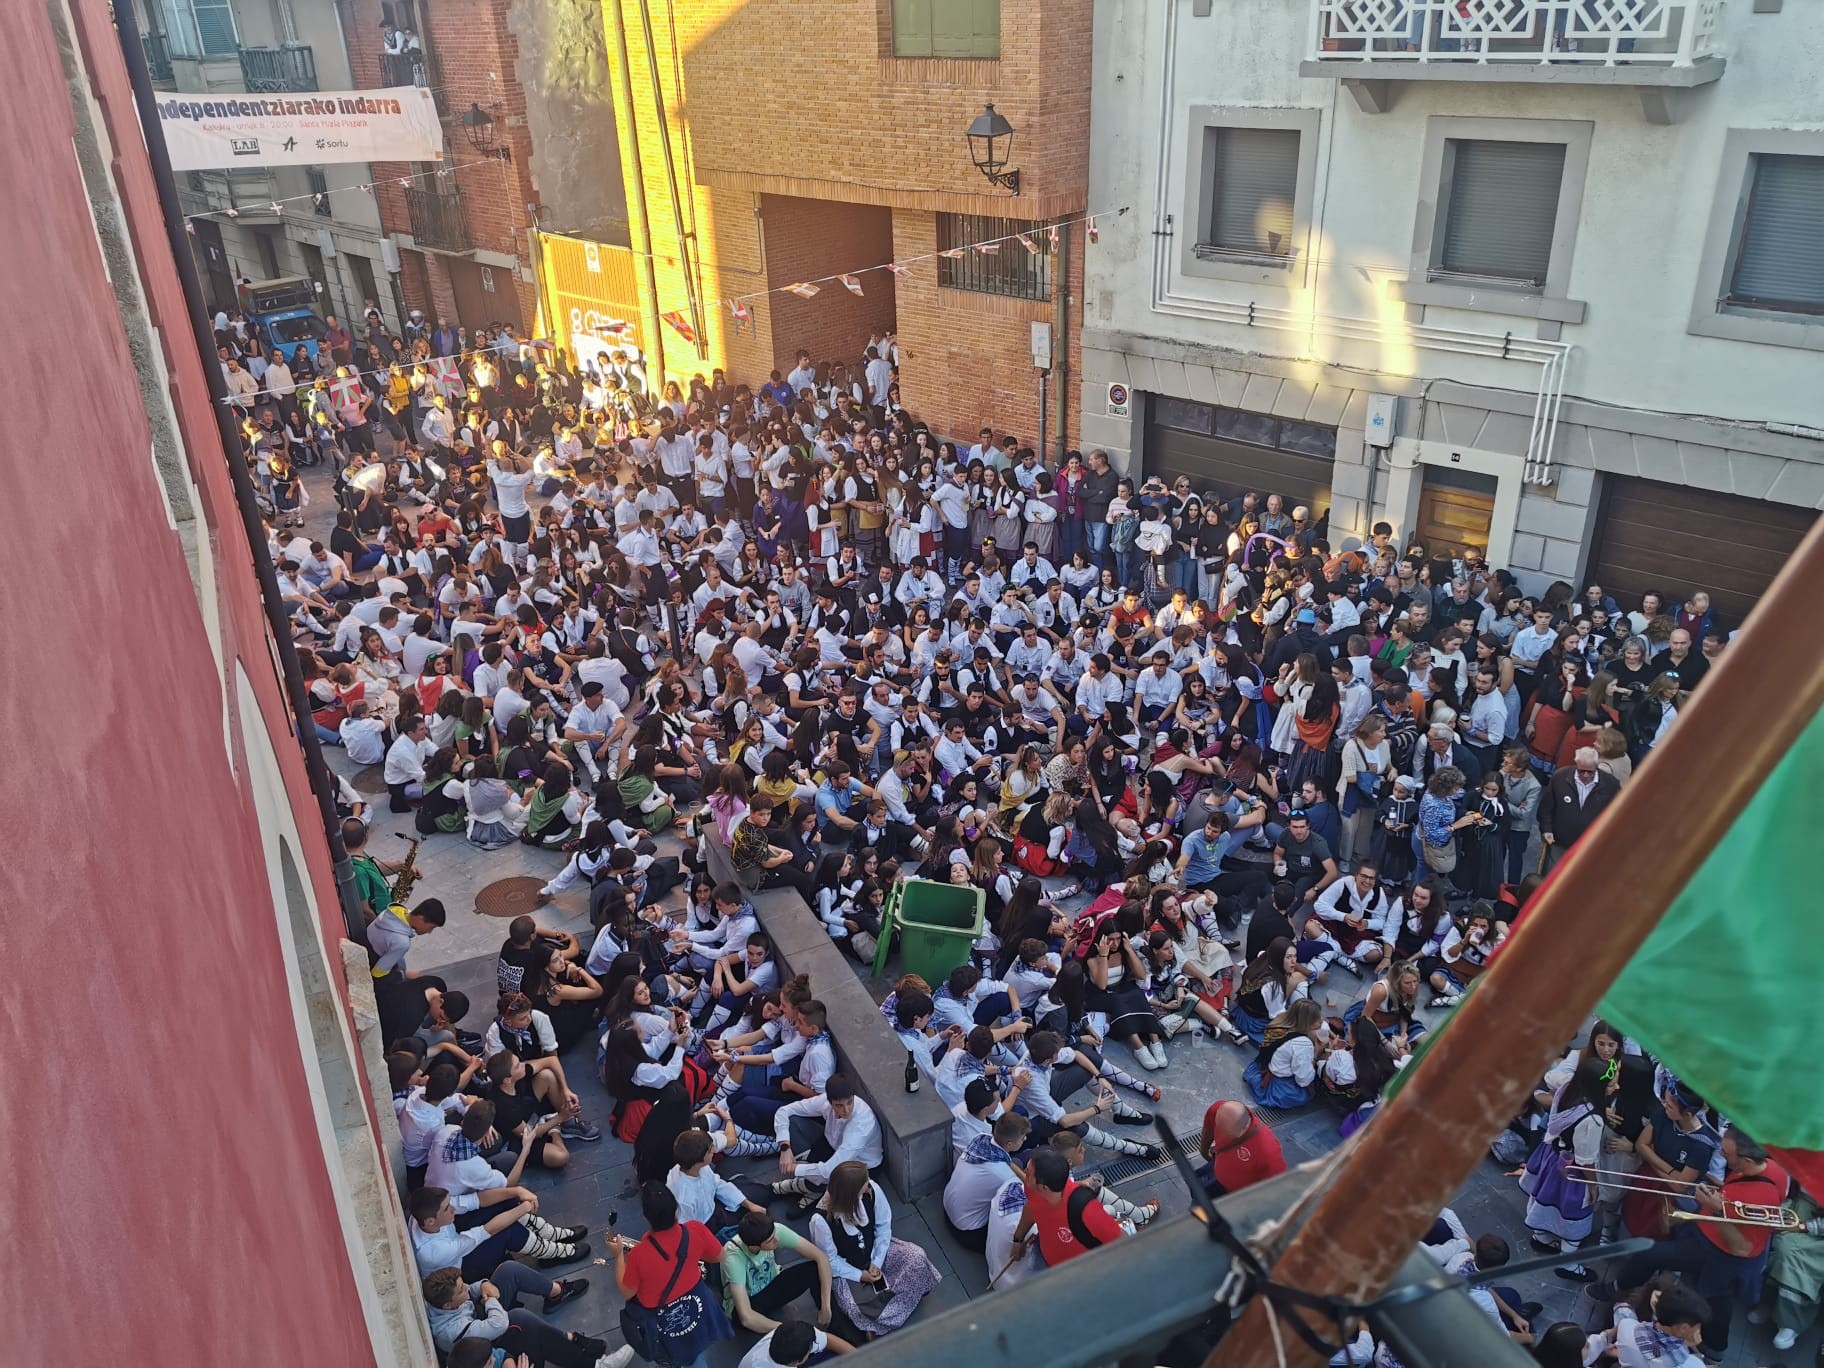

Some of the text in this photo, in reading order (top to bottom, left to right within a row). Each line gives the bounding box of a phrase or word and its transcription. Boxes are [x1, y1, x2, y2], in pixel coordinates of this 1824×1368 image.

[336, 96, 402, 115] indarra
[232, 140, 258, 150] LAB
[326, 140, 349, 148] sortu
[669, 1321, 698, 1337] GASTEIZ
